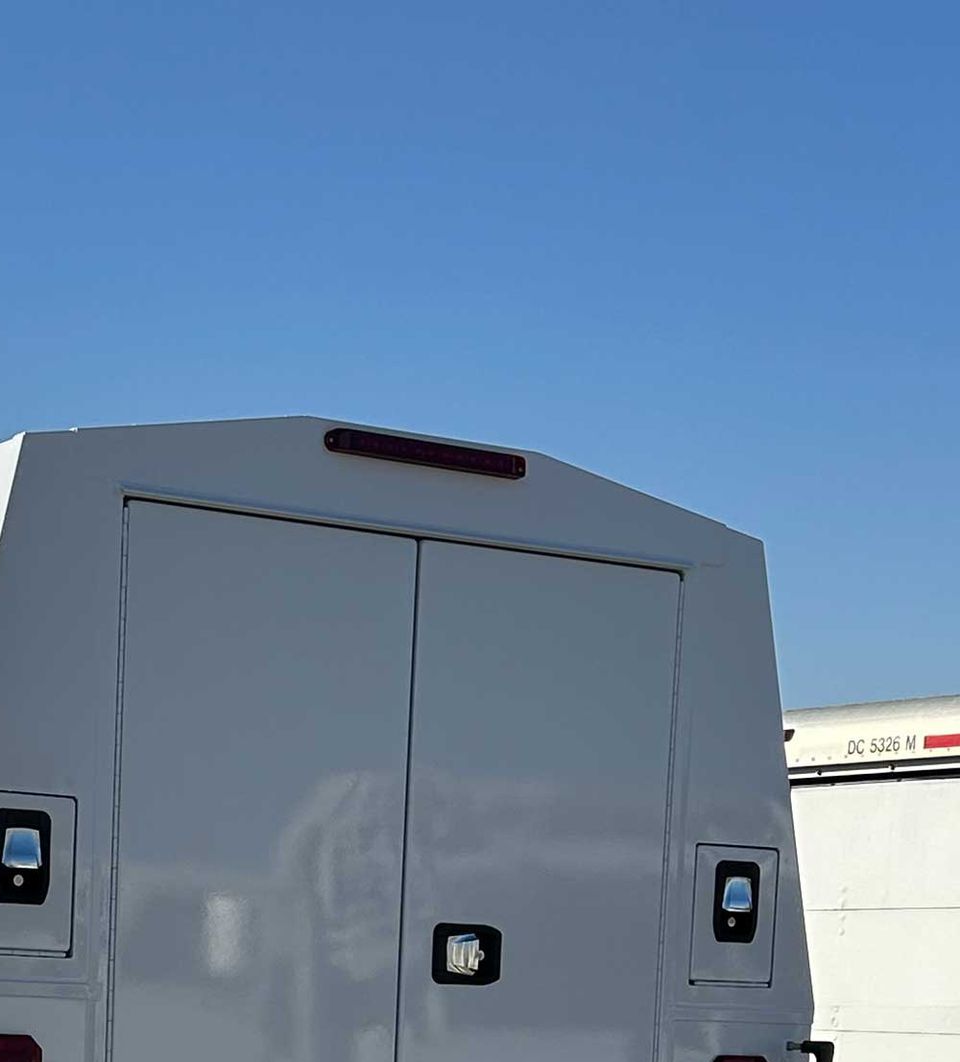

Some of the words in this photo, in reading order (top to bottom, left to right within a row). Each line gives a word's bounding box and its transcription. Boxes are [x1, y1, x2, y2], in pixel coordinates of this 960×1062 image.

[847, 739, 865, 755] DC
[869, 736, 901, 753] 5326
[905, 734, 917, 751] M
